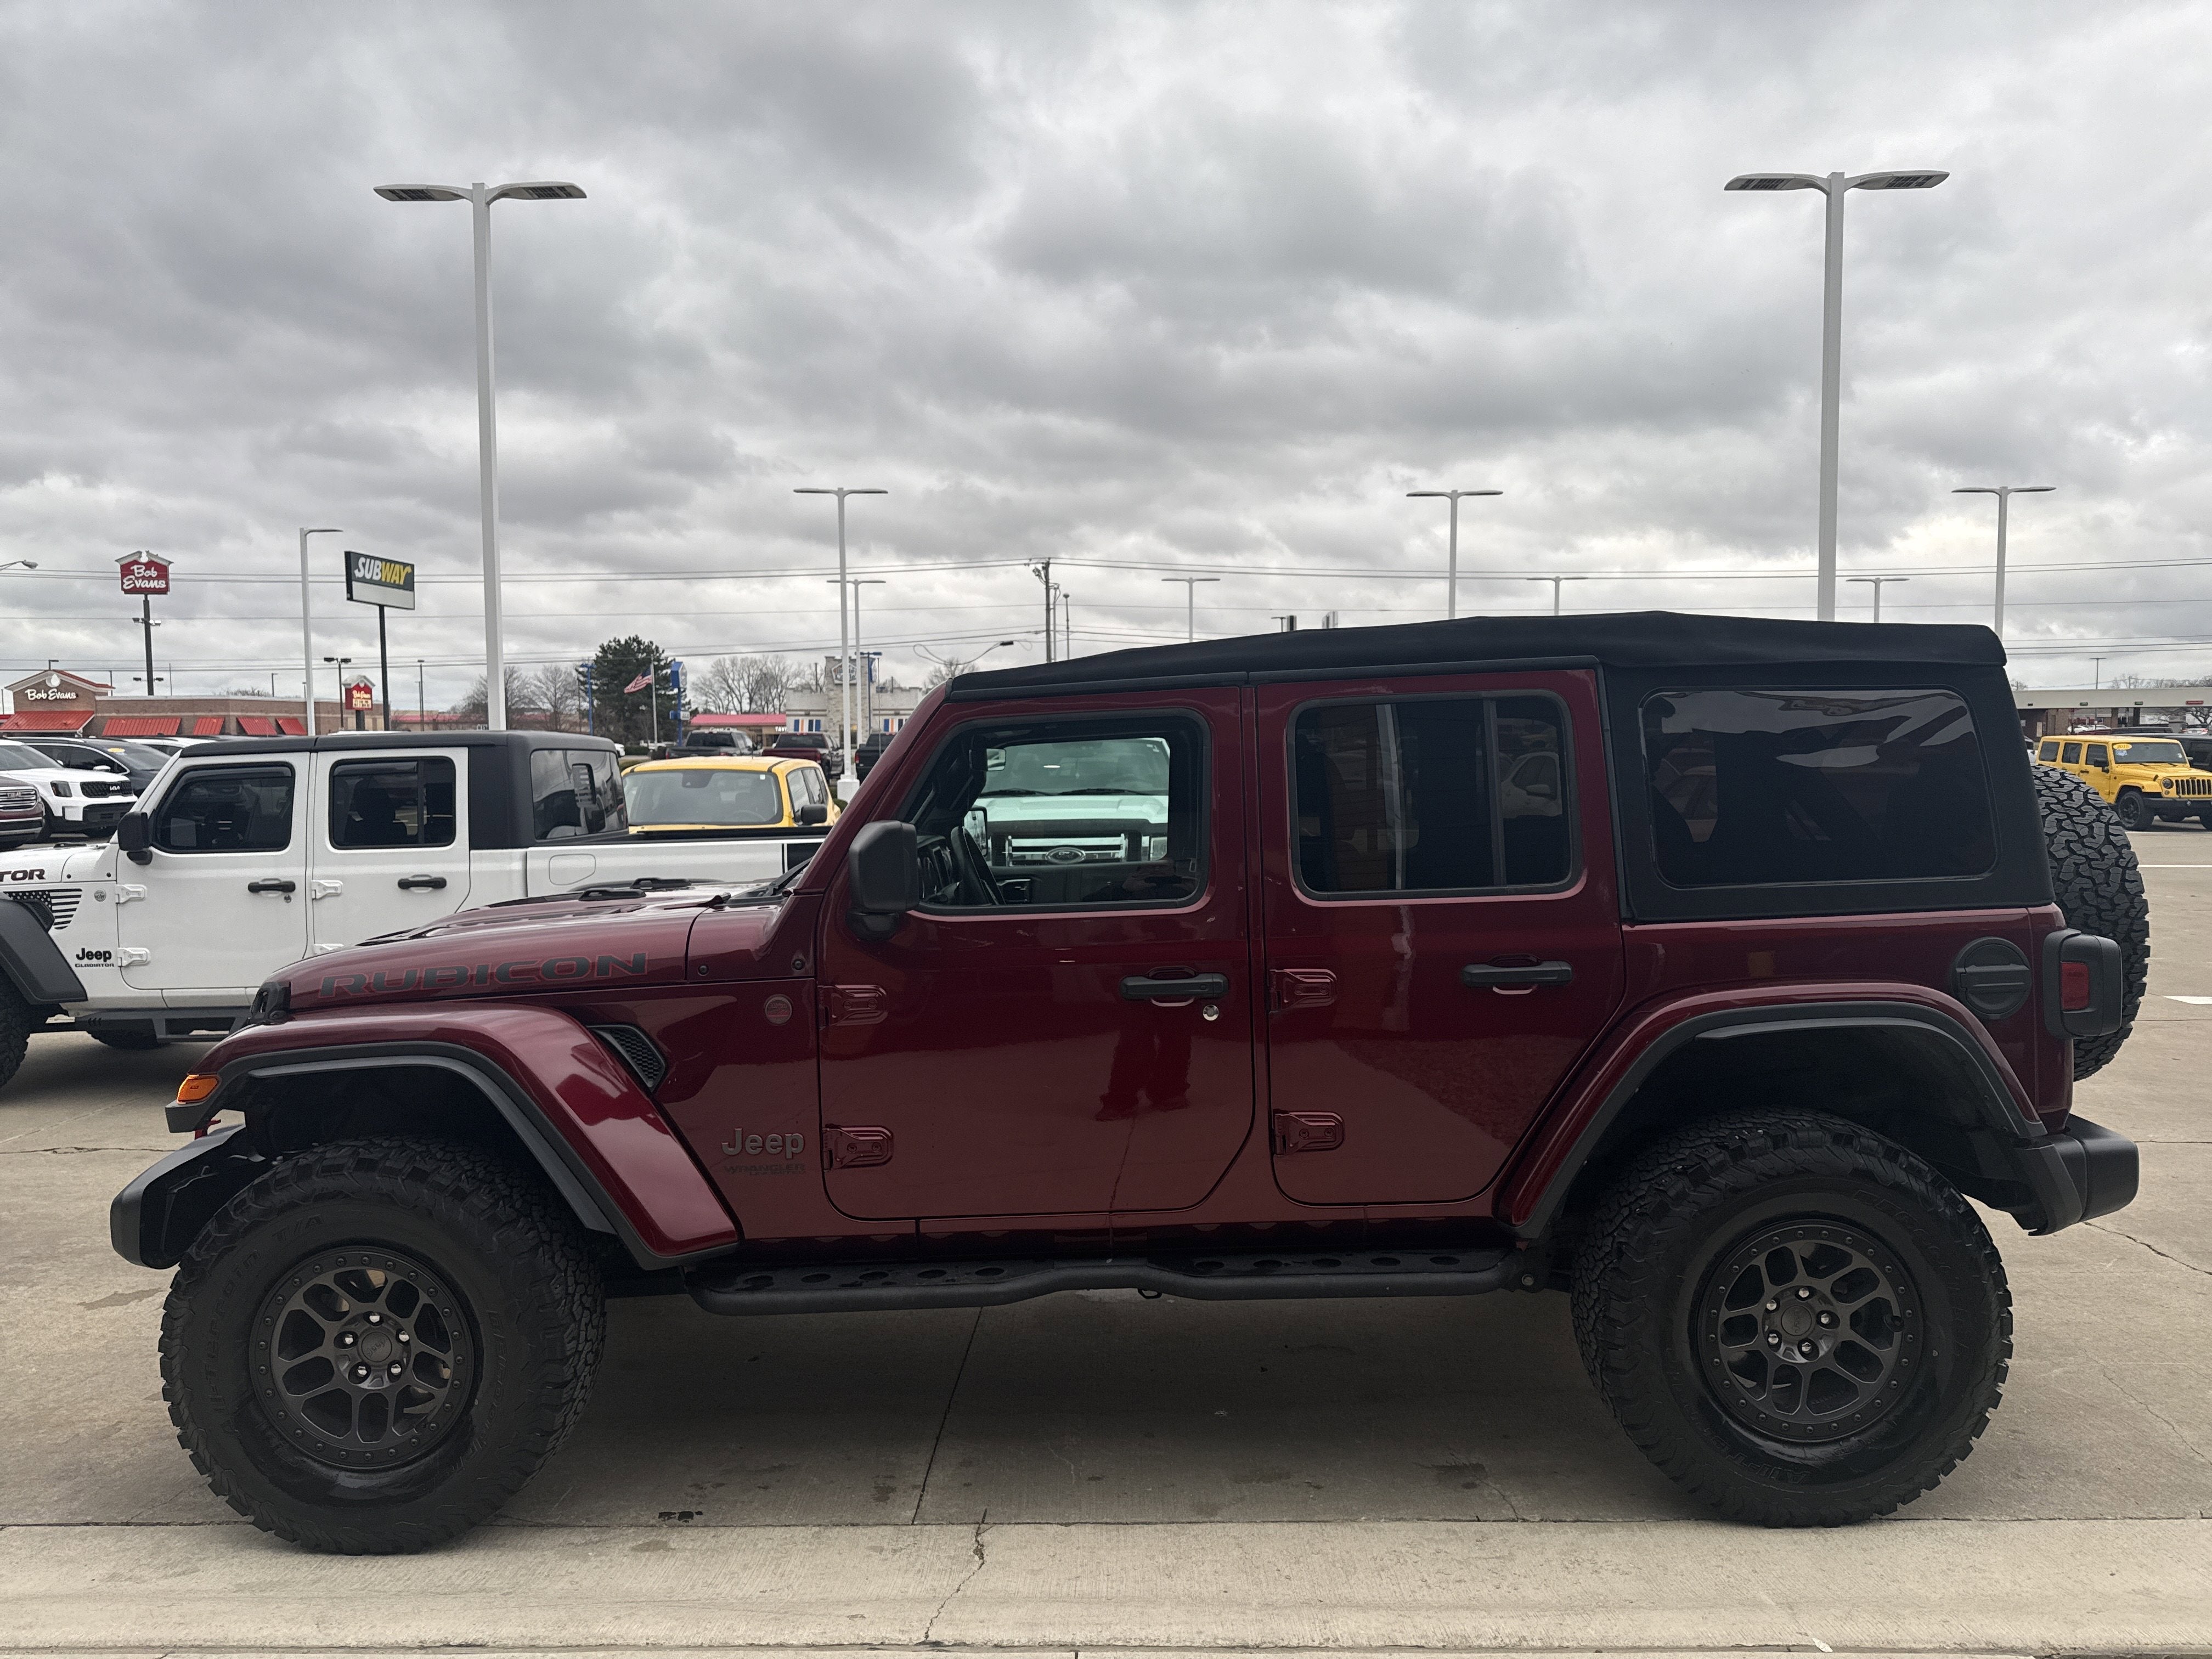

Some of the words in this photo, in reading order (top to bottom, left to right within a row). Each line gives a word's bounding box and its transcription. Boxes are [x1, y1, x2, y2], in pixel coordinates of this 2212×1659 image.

[130, 565, 157, 577] Bob
[354, 556, 412, 585] SUBWAY
[123, 575, 166, 589] Evans
[25, 689, 47, 700] Bob
[48, 688, 76, 700] Evans
[76, 947, 112, 962] Jeep
[319, 952, 648, 998] RUBICON
[721, 1128, 805, 1159] Jeep
